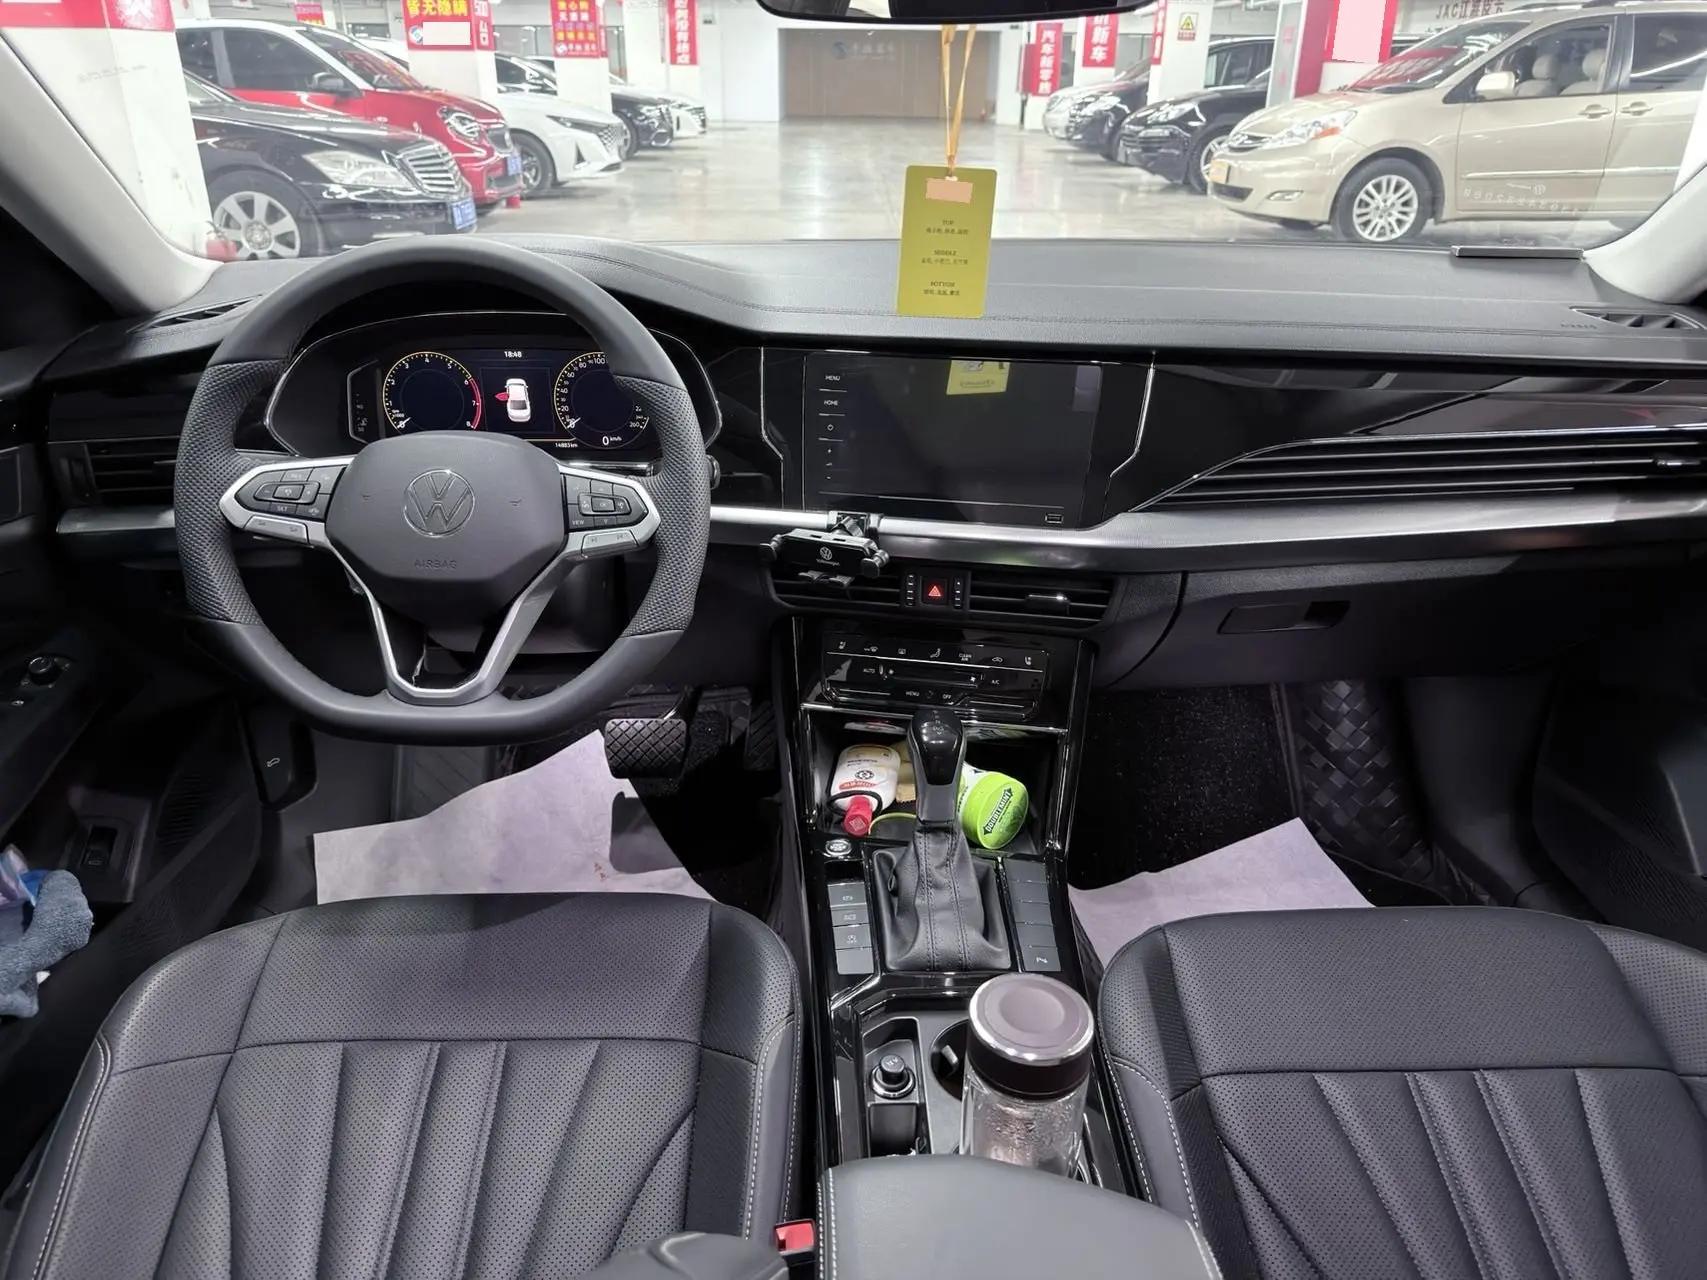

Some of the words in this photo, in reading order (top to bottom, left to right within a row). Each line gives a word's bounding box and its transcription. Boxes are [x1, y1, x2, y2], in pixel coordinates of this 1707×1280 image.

[578, 361, 587, 369] 80
[593, 357, 606, 365] 100
[602, 435, 610, 446] 0
[414, 559, 457, 570] AIRBAG
